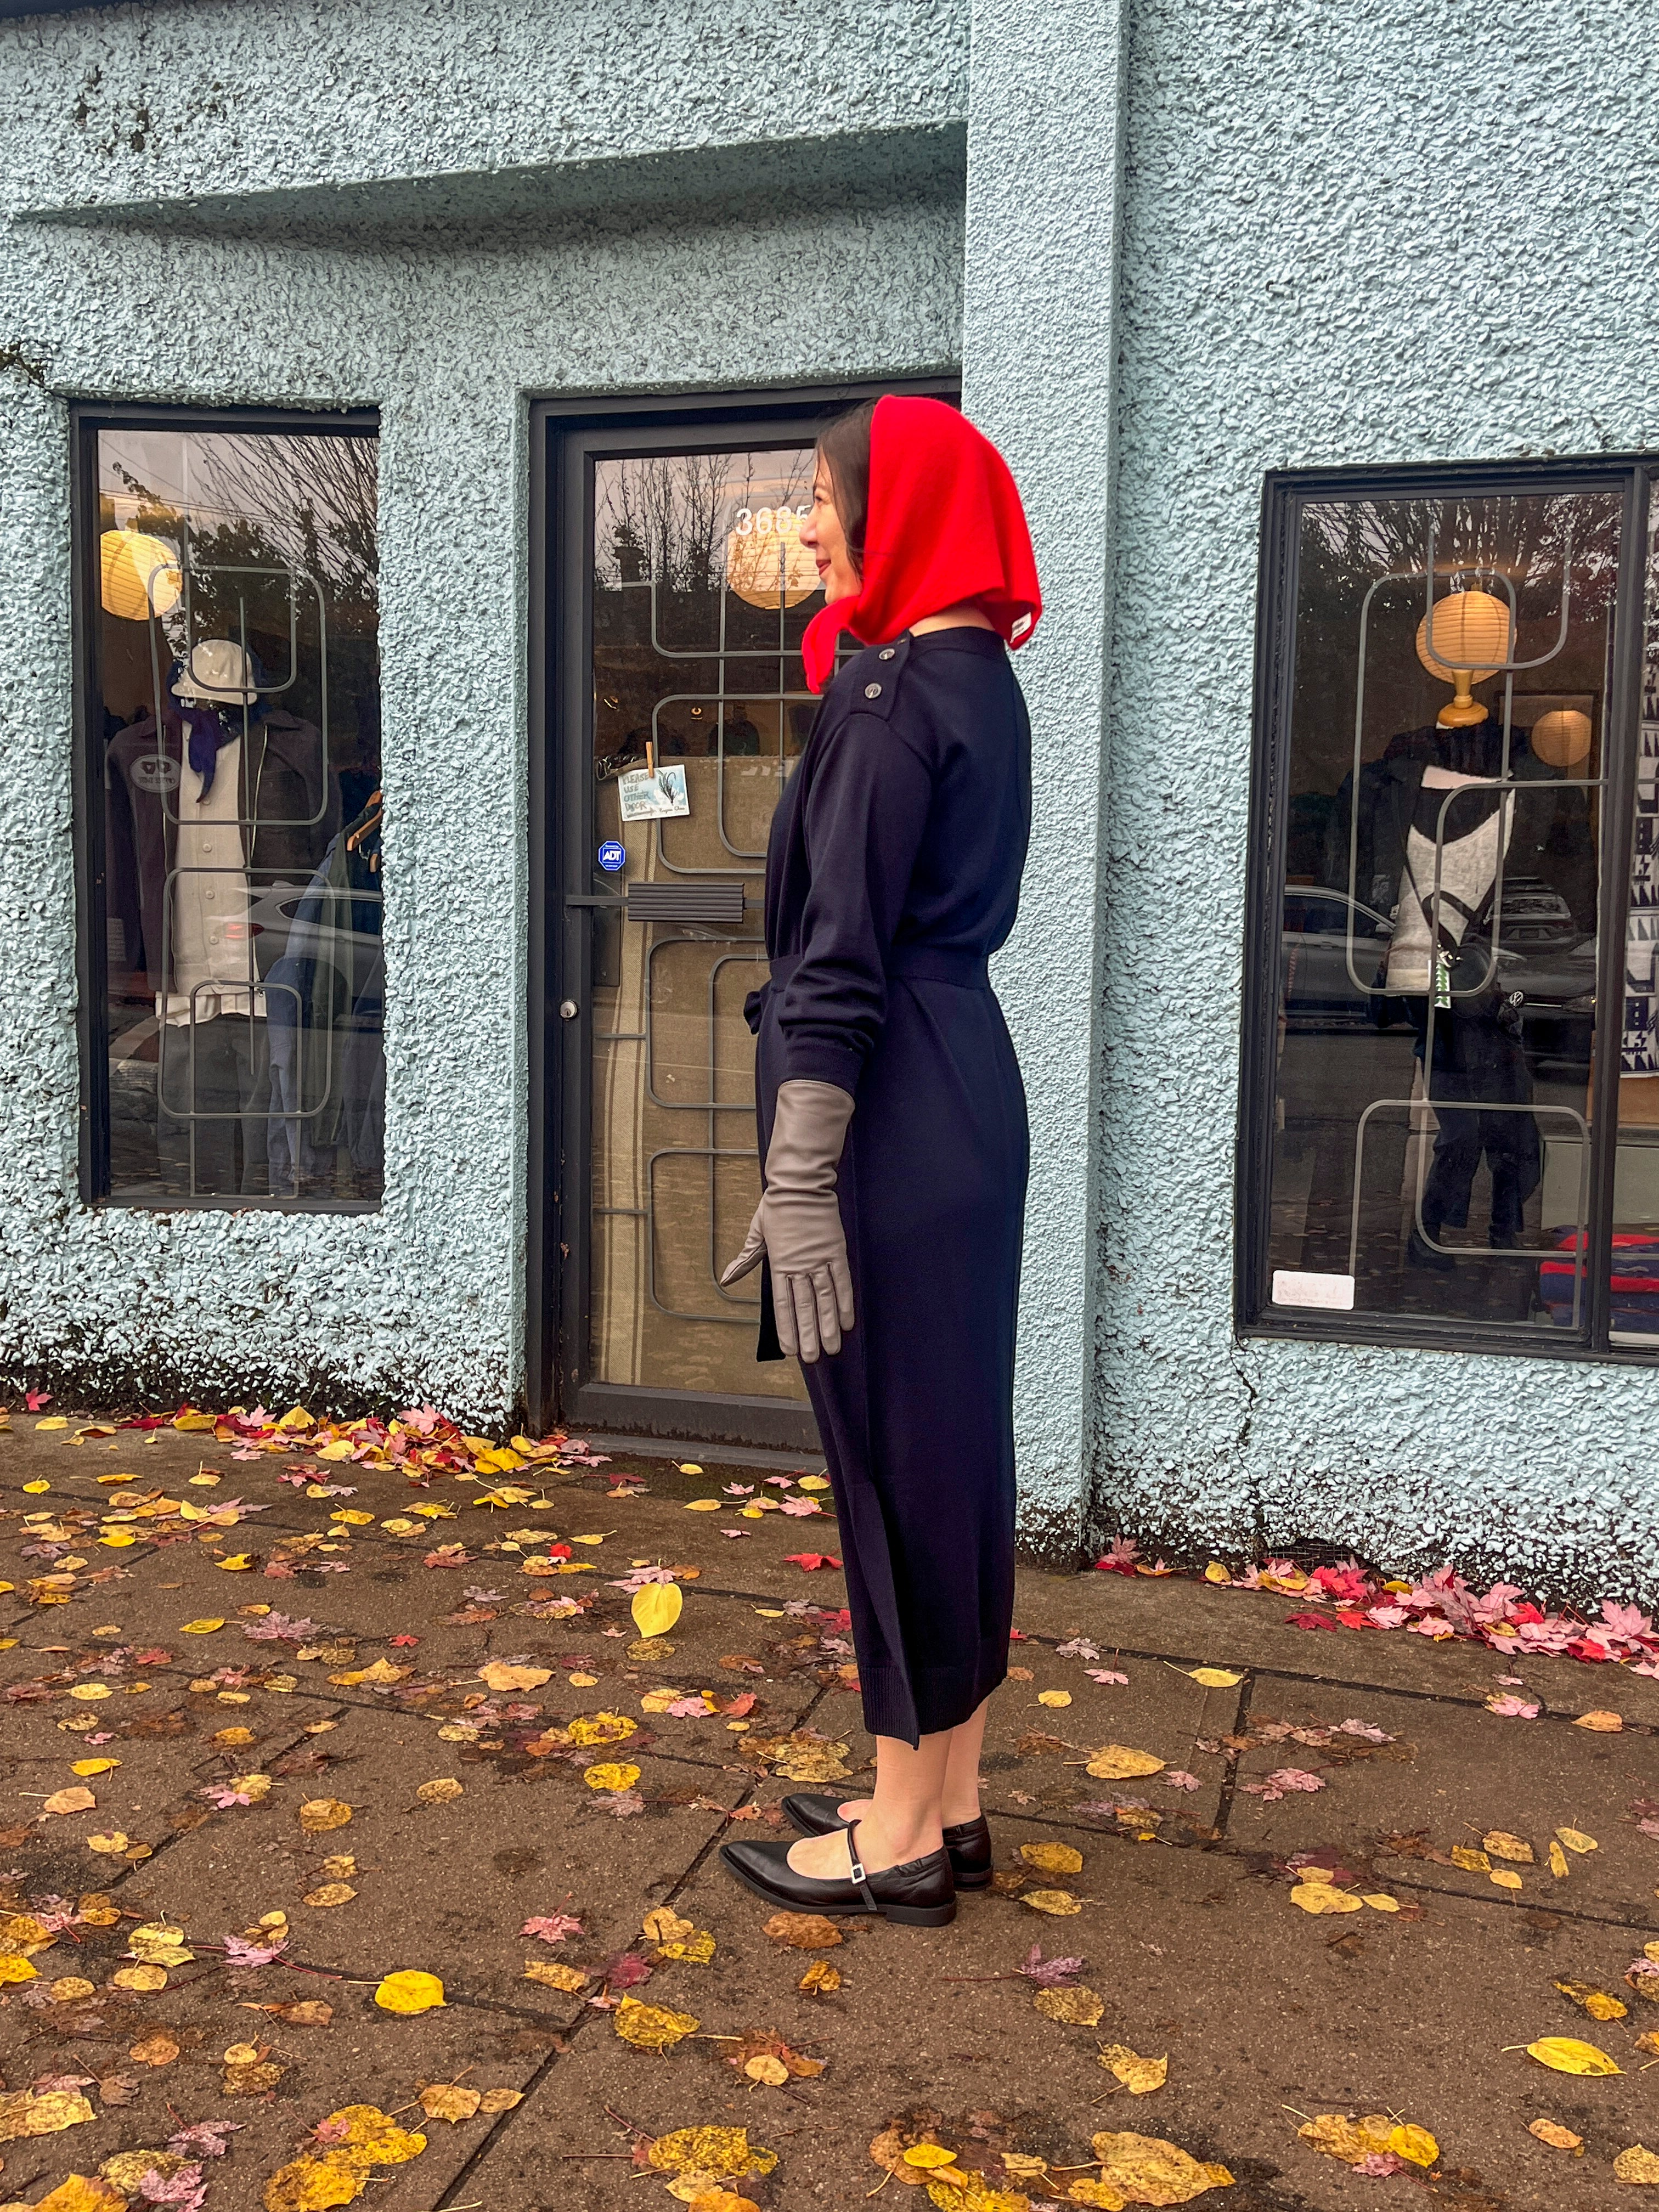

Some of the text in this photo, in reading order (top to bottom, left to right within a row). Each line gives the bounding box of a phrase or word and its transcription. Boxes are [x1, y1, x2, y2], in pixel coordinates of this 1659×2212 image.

[622, 772, 650, 784] PLEASE
[624, 784, 639, 793] USE
[625, 801, 647, 812] DOOR
[603, 850, 620, 861] ADT
